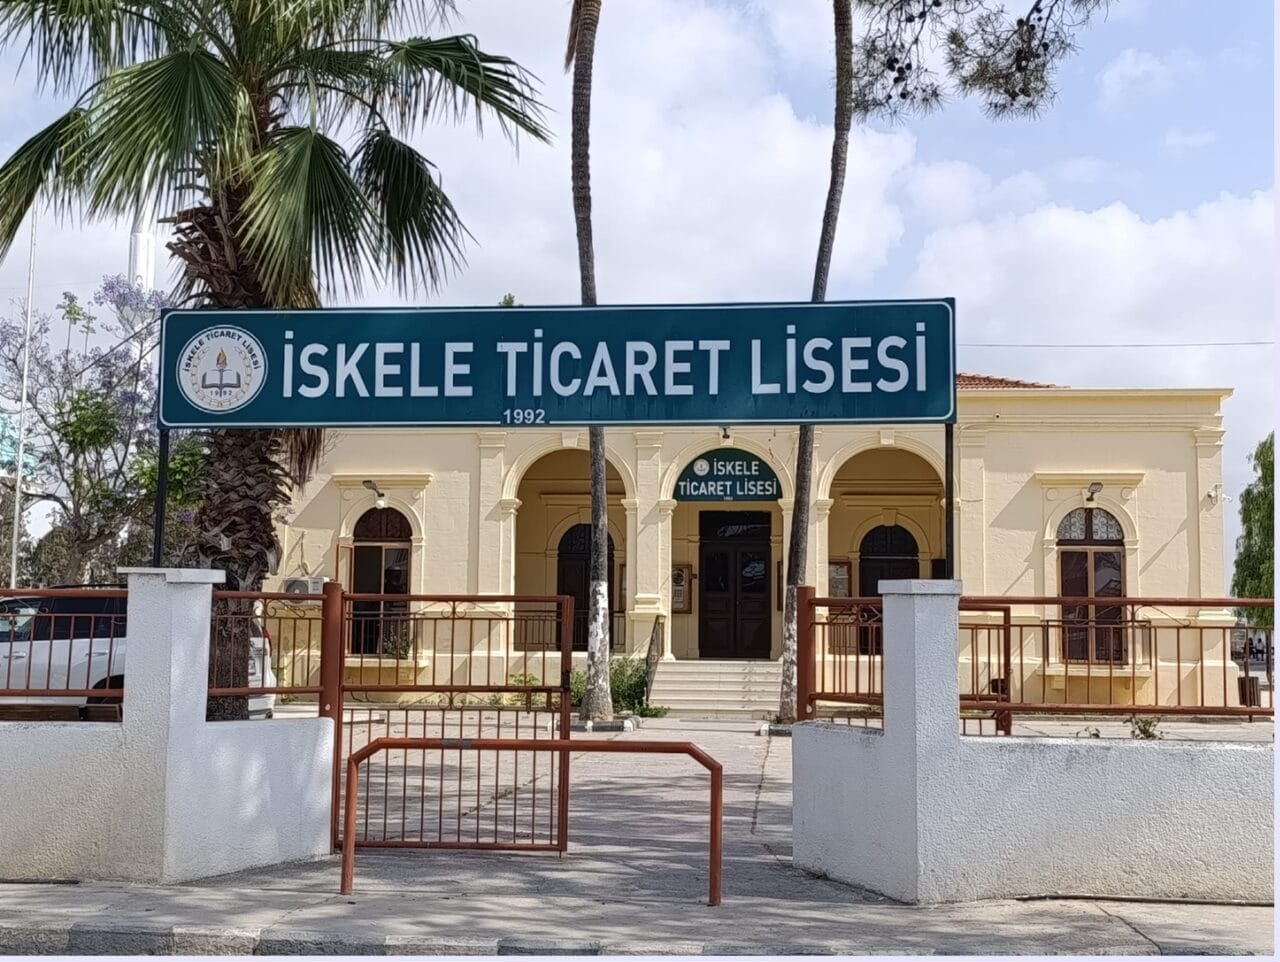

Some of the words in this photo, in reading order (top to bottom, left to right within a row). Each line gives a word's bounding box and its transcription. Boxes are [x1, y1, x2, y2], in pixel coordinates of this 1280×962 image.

[183, 338, 206, 372] İSKELE
[205, 330, 242, 342] TİCARET
[241, 340, 262, 370] LİSESİ
[282, 330, 474, 398] İSKELE
[496, 328, 731, 397] TİCARET
[751, 322, 927, 394] LİSESİ
[502, 408, 546, 425] 1992
[713, 458, 760, 476] İSKELE
[678, 478, 733, 496] TİCARET
[736, 478, 777, 496] LİSESİ
